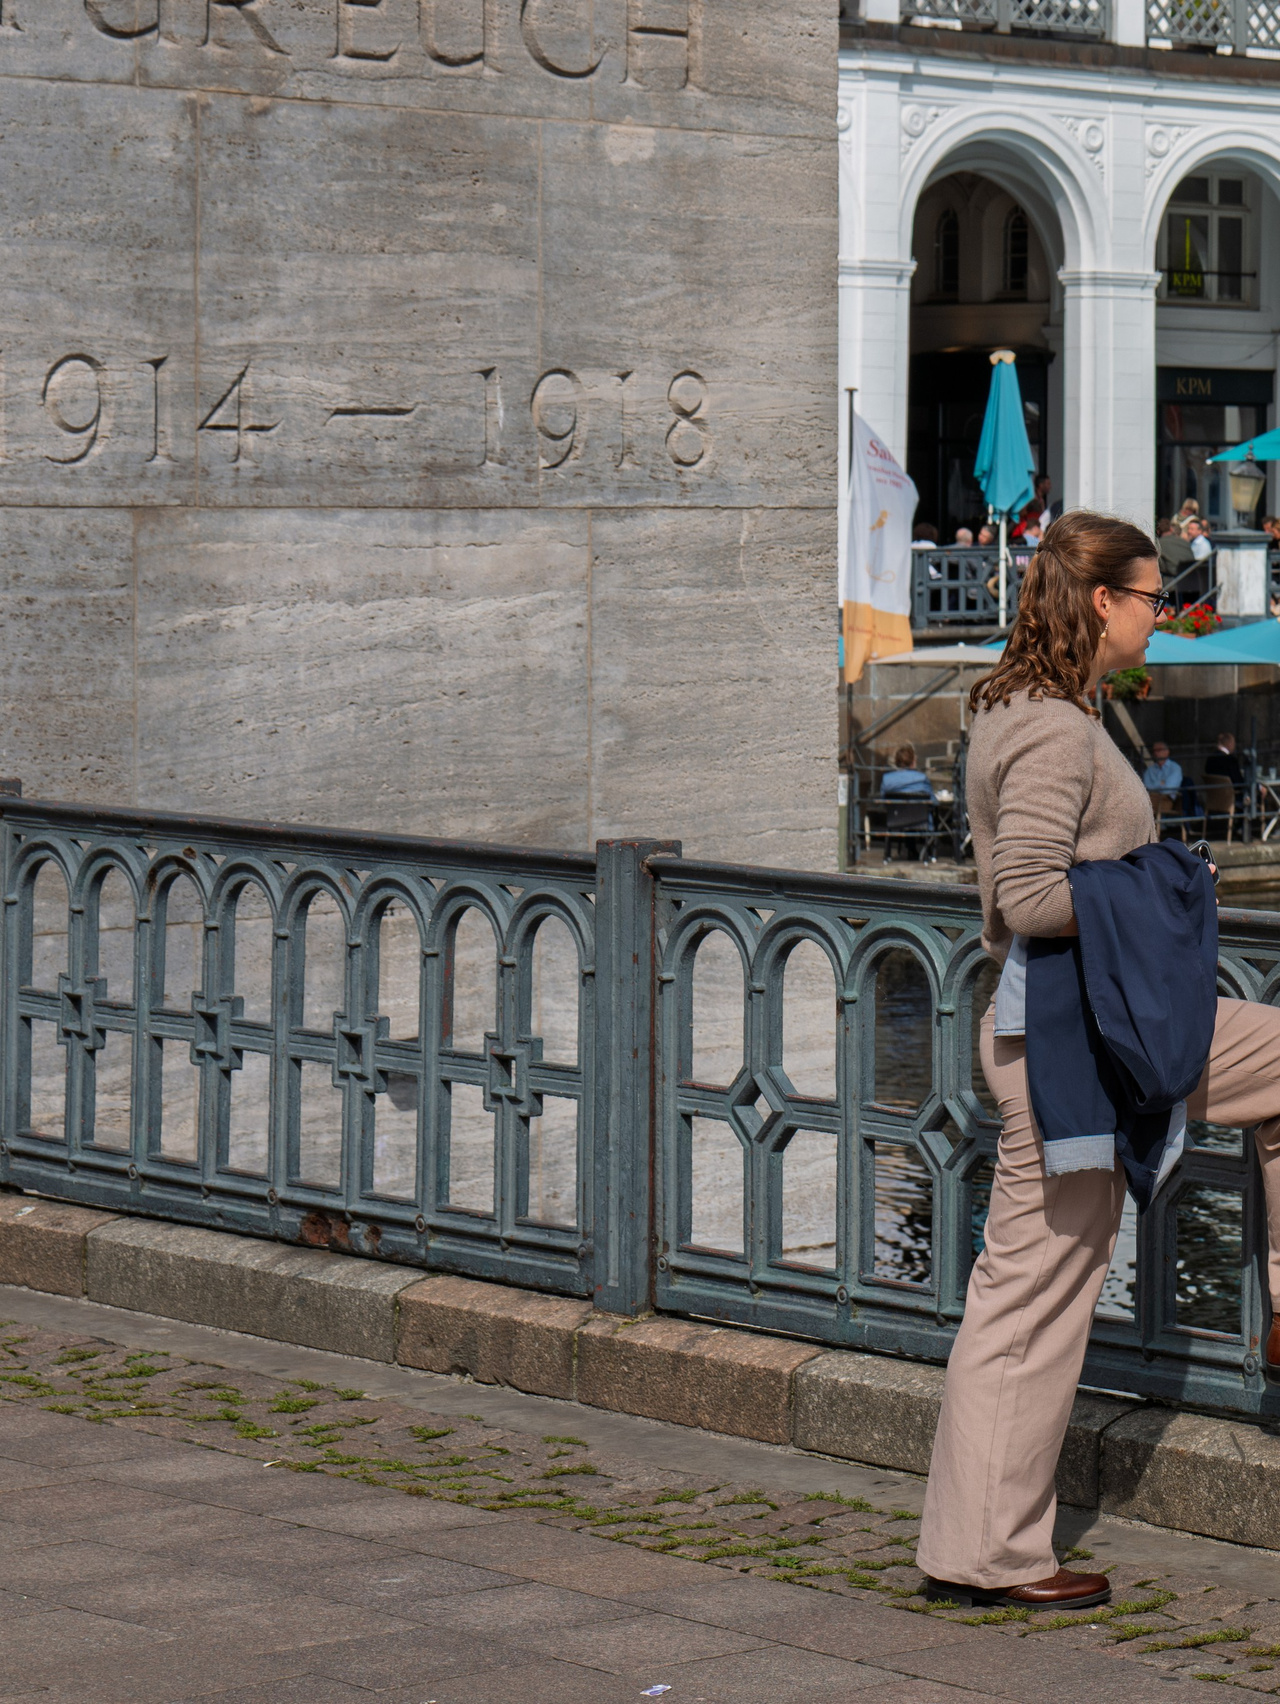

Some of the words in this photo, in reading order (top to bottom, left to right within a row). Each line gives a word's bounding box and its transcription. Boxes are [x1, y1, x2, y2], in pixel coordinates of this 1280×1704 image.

[1173, 272, 1202, 287] KPM
[1177, 377, 1212, 396] KPM
[0, 352, 282, 465] 914
[472, 366, 714, 469] 1918
